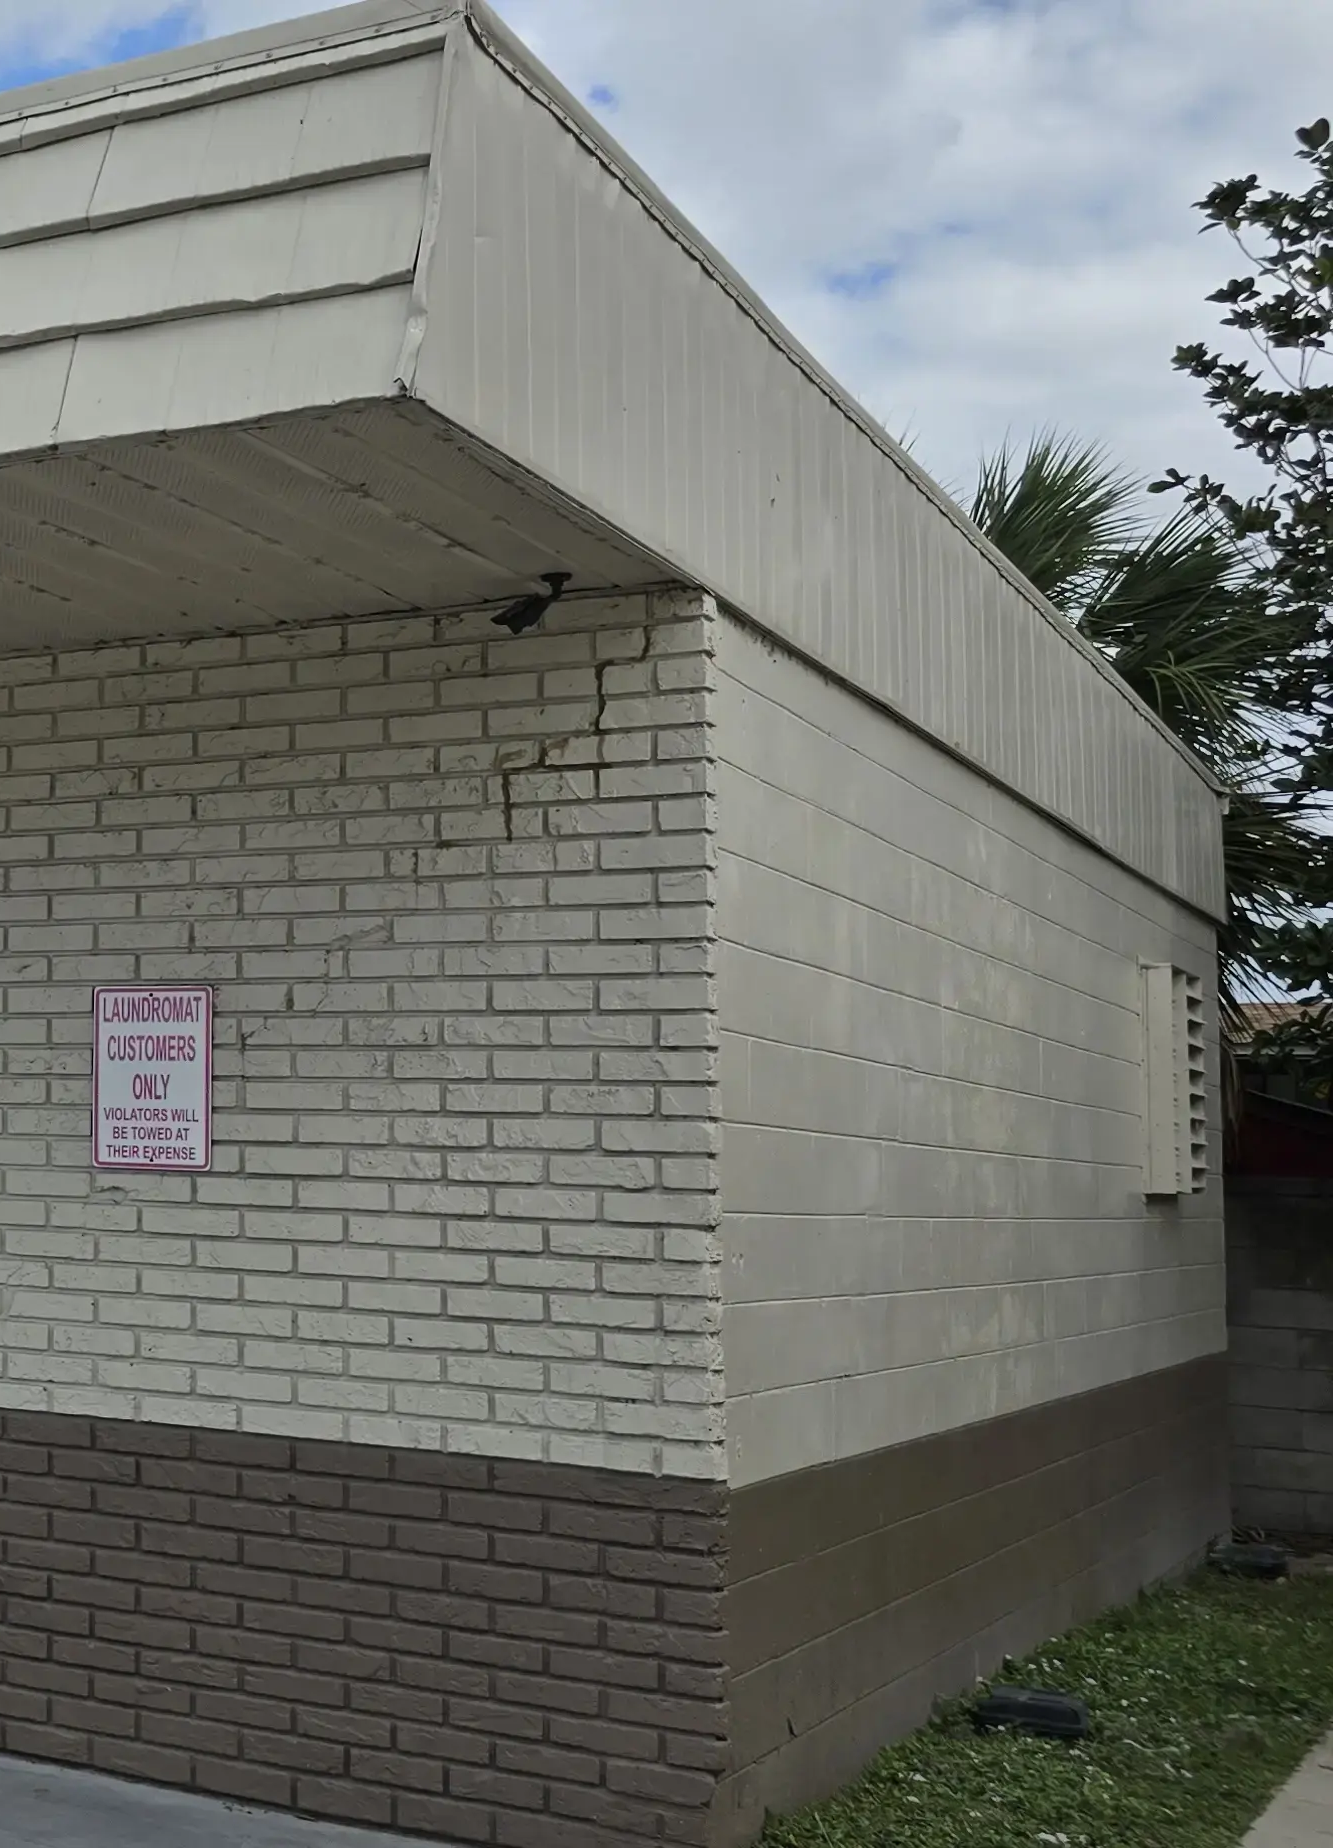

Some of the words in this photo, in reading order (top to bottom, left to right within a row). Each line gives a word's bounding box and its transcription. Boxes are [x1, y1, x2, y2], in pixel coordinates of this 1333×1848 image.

[103, 996, 202, 1023] LAUNDROMAT
[107, 1035, 196, 1062] CUSTOMERS
[132, 1073, 171, 1100] ONLY
[103, 1108, 168, 1122] VIOLATORS
[170, 1109, 199, 1123] WILL
[112, 1126, 128, 1140] BE
[132, 1127, 173, 1141] TOWED
[175, 1128, 190, 1141] AT
[106, 1144, 139, 1158] THEIR
[143, 1146, 196, 1160] EXPENSE
